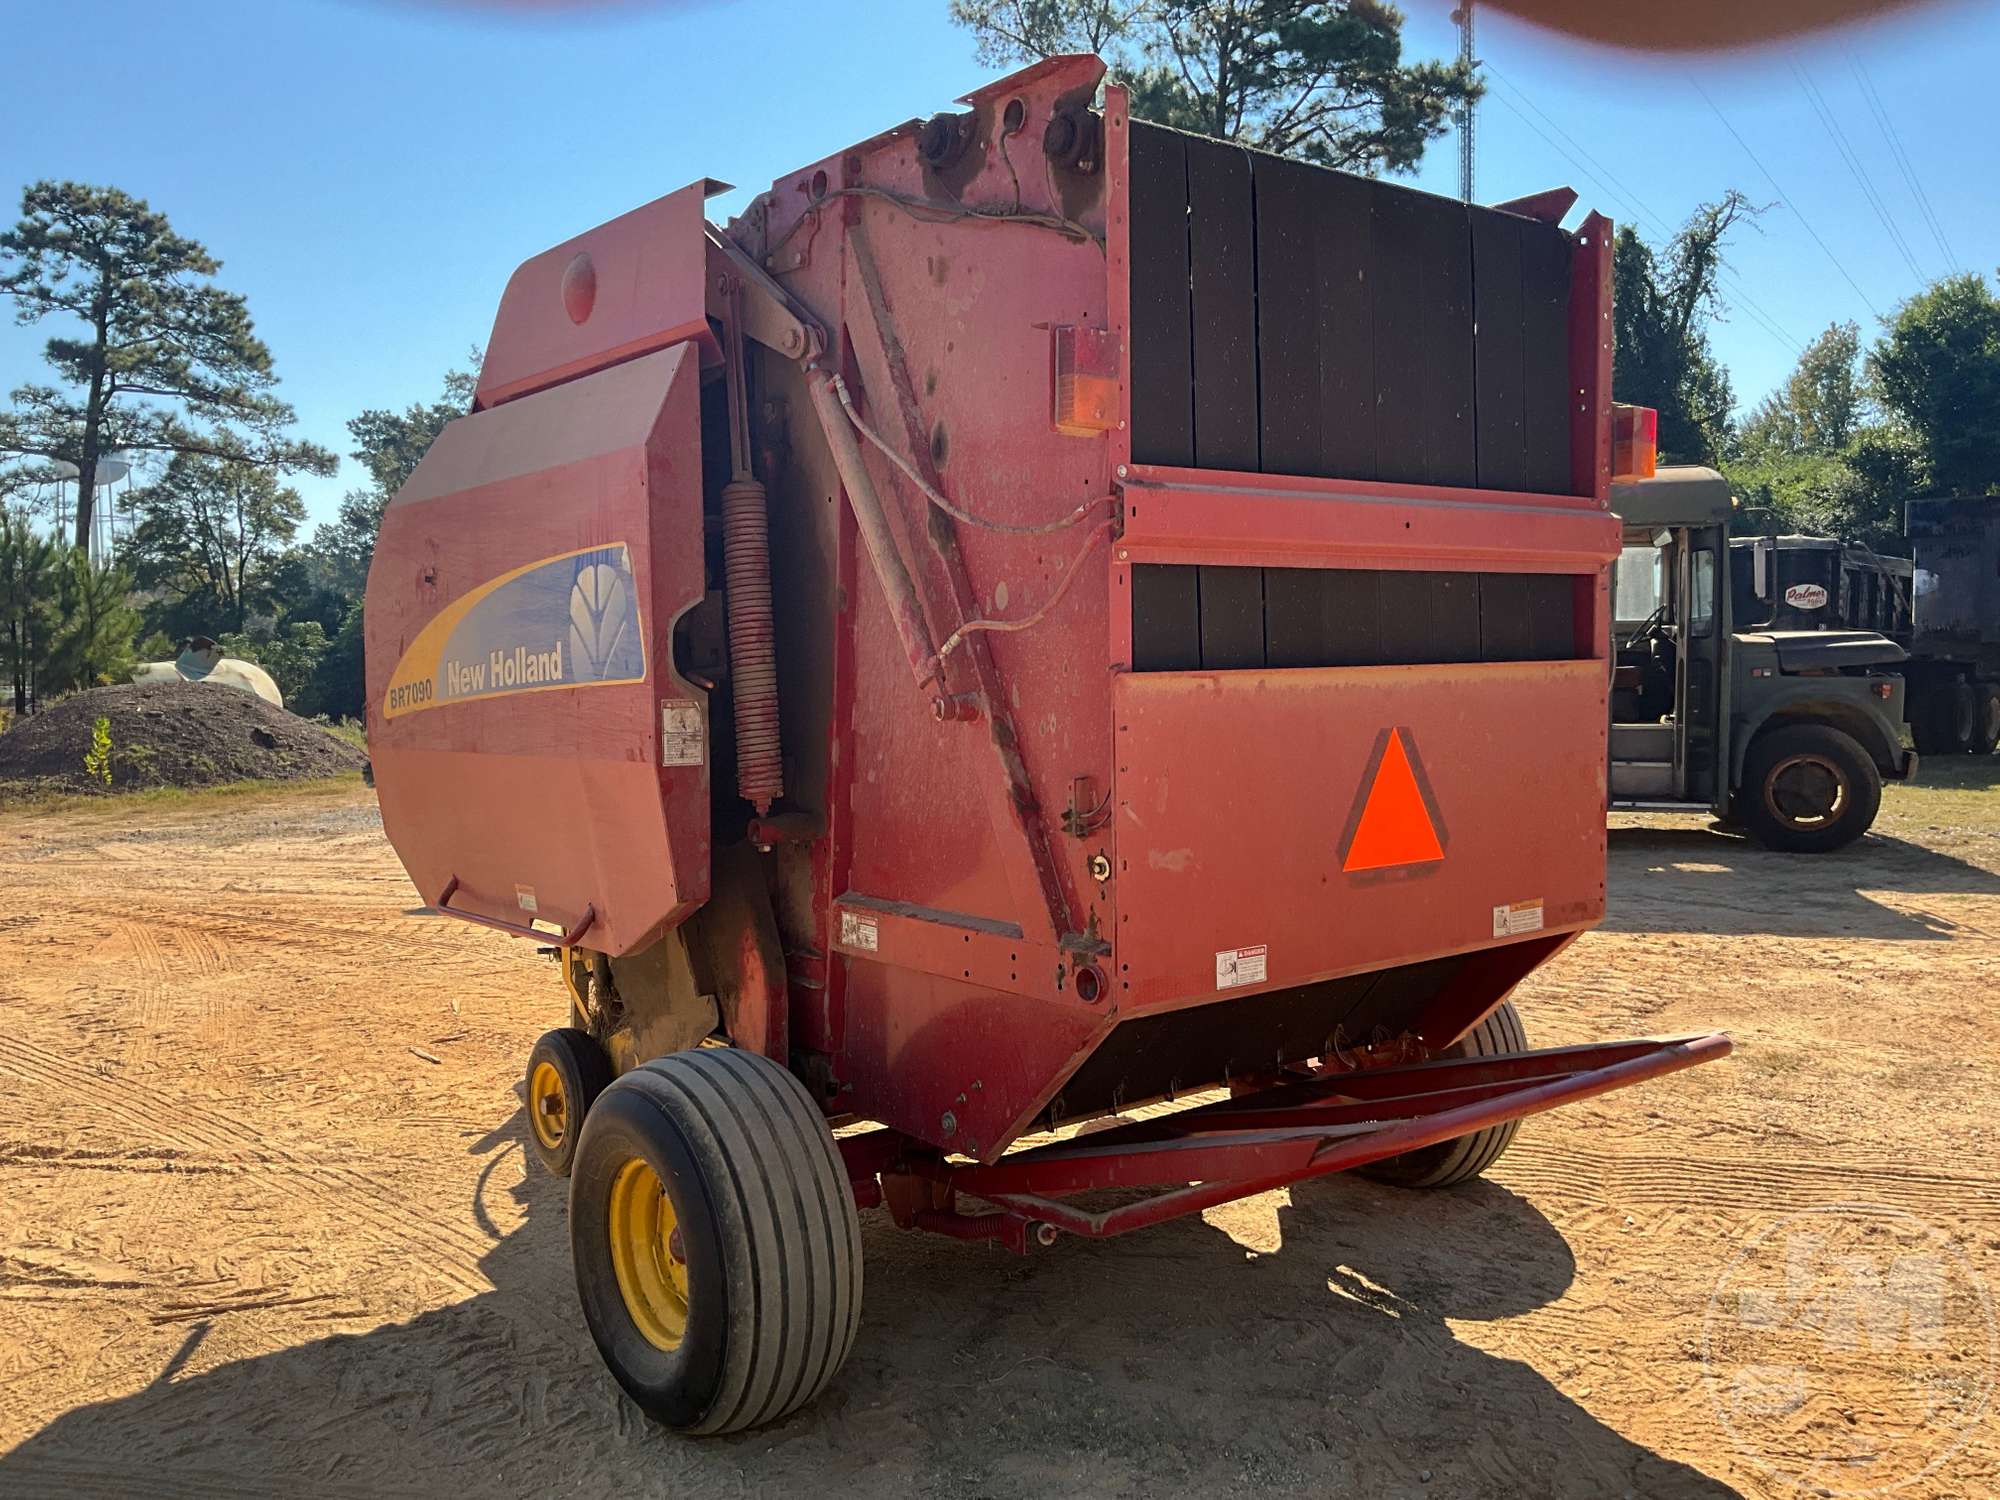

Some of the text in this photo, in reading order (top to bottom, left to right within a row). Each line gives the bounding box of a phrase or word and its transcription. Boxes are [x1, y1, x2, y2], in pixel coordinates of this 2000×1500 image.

[1787, 586, 1824, 600] Palmer
[447, 640, 562, 696] New Holland
[390, 678, 432, 708] BR7090
